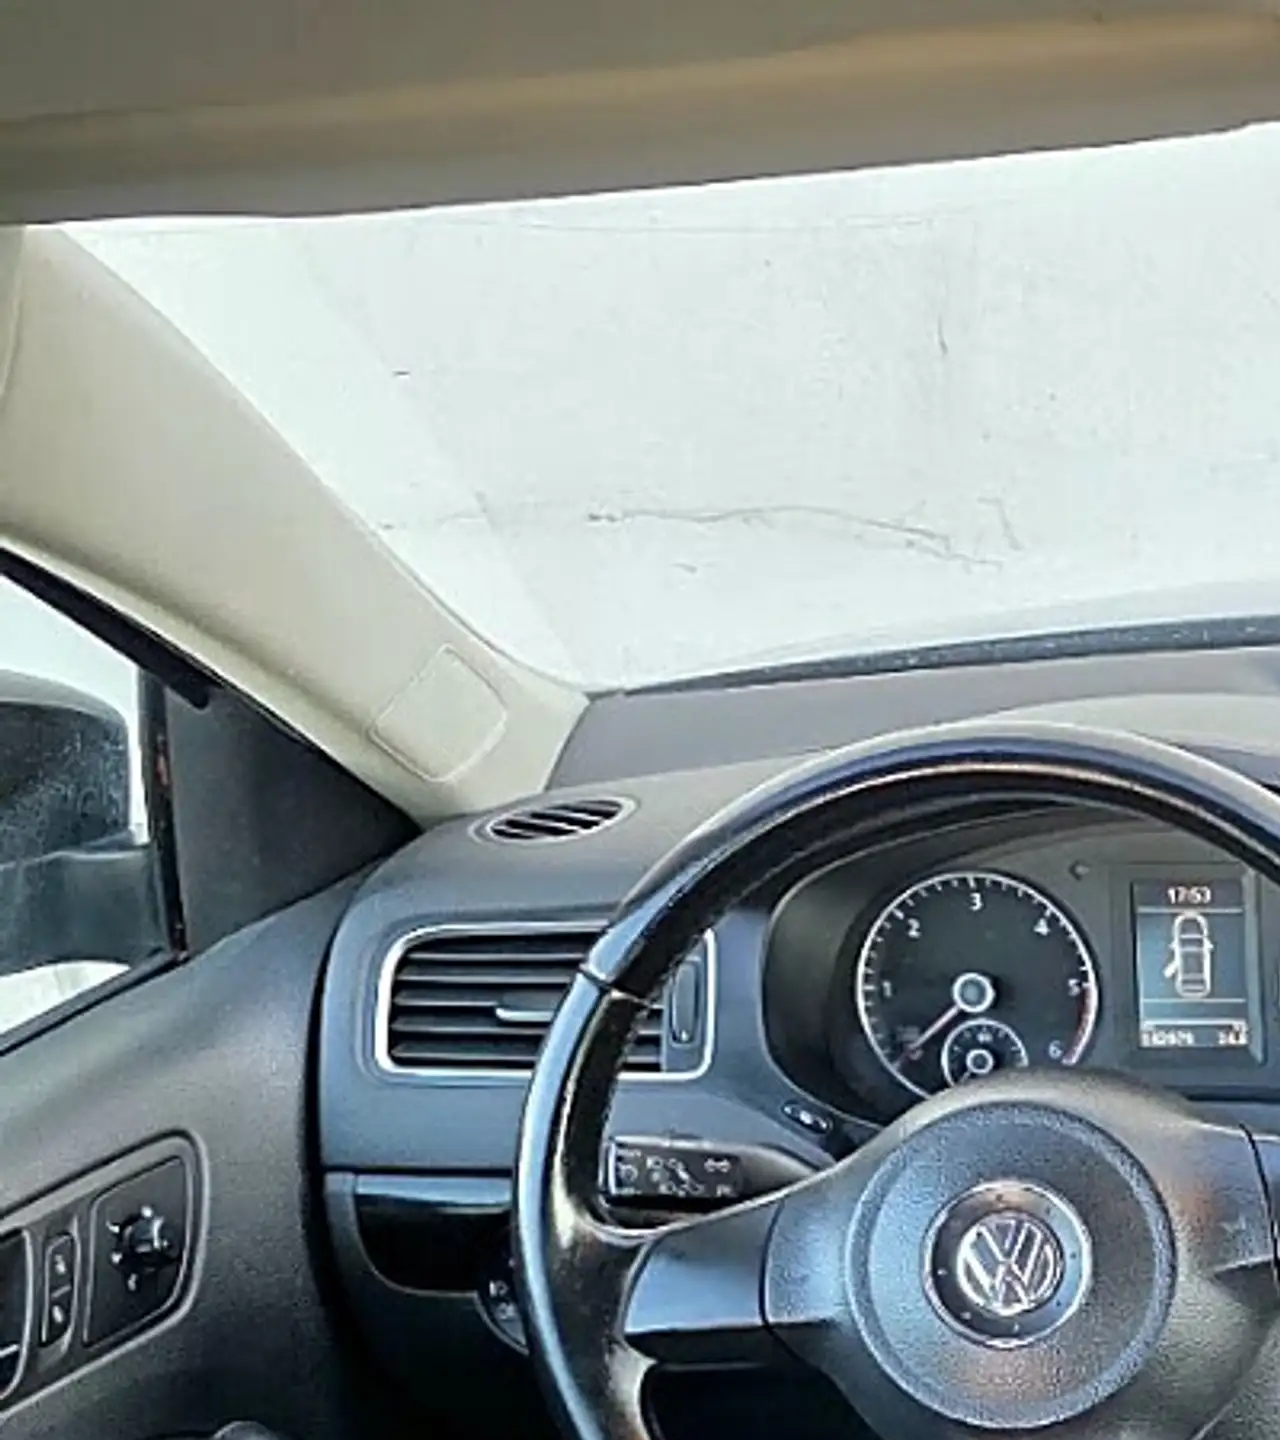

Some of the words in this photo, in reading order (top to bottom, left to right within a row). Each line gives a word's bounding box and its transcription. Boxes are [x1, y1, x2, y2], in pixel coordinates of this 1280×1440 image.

[968, 892, 983, 912] 3
[906, 918, 922, 939] 2
[1033, 917, 1051, 937] 4
[882, 980, 893, 999] 1
[1067, 978, 1082, 997] 5
[1047, 1039, 1064, 1060] 6
